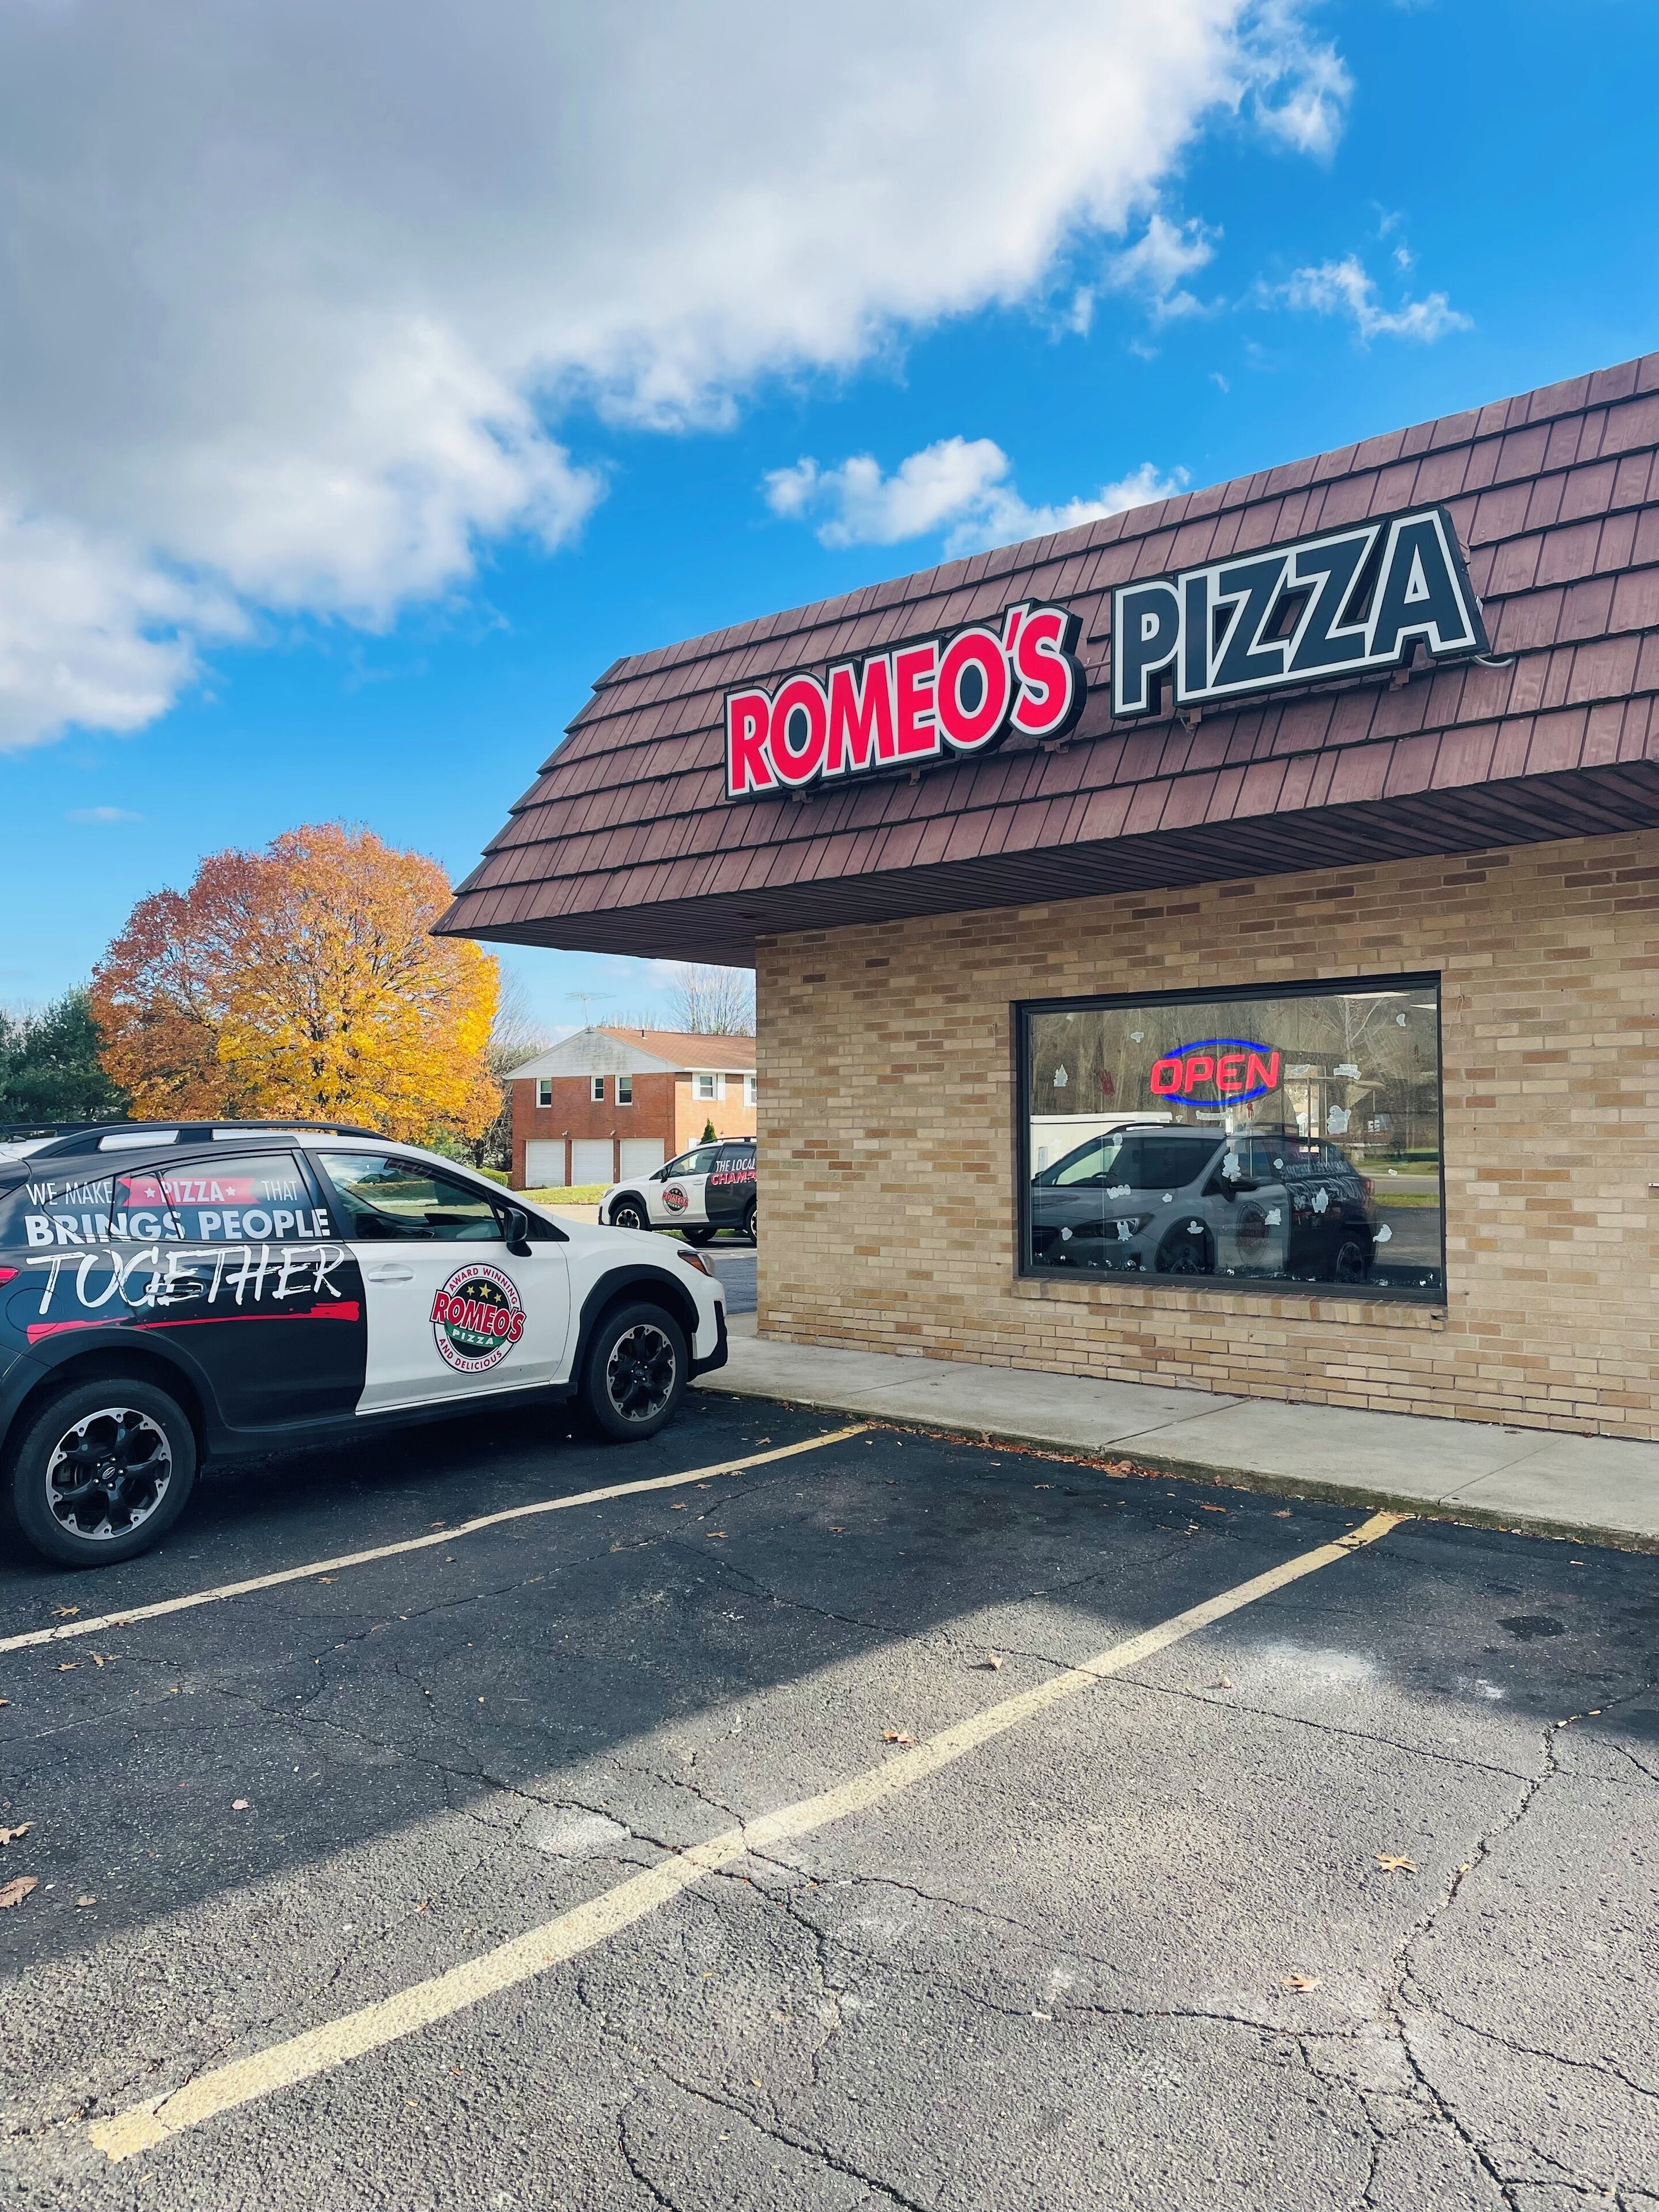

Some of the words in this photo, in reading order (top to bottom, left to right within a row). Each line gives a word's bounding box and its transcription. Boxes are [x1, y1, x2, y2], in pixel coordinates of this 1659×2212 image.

[727, 600, 1073, 796] ROMEO'S
[1114, 510, 1476, 714] PIZZA
[1151, 1052, 1279, 1094] OPEN
[711, 1171, 757, 1185] CHAMP
[715, 1160, 730, 1172] THE
[731, 1158, 755, 1171] LOCAL
[25, 1182, 58, 1206] WE
[65, 1181, 115, 1205] MAKE
[160, 1181, 225, 1203] PIZZA
[261, 1181, 297, 1201] THAT
[25, 1211, 185, 1247] BRINGS
[198, 1209, 330, 1240] PEOPLE
[26, 1244, 346, 1314] TOGETHER
[449, 1267, 478, 1291] AWARD
[483, 1267, 517, 1304] WINNING
[431, 1290, 526, 1343] ROMEO'S
[439, 1338, 453, 1359] AND
[455, 1351, 502, 1370] DELICIOUS
[452, 1328, 494, 1345] PIZZA
